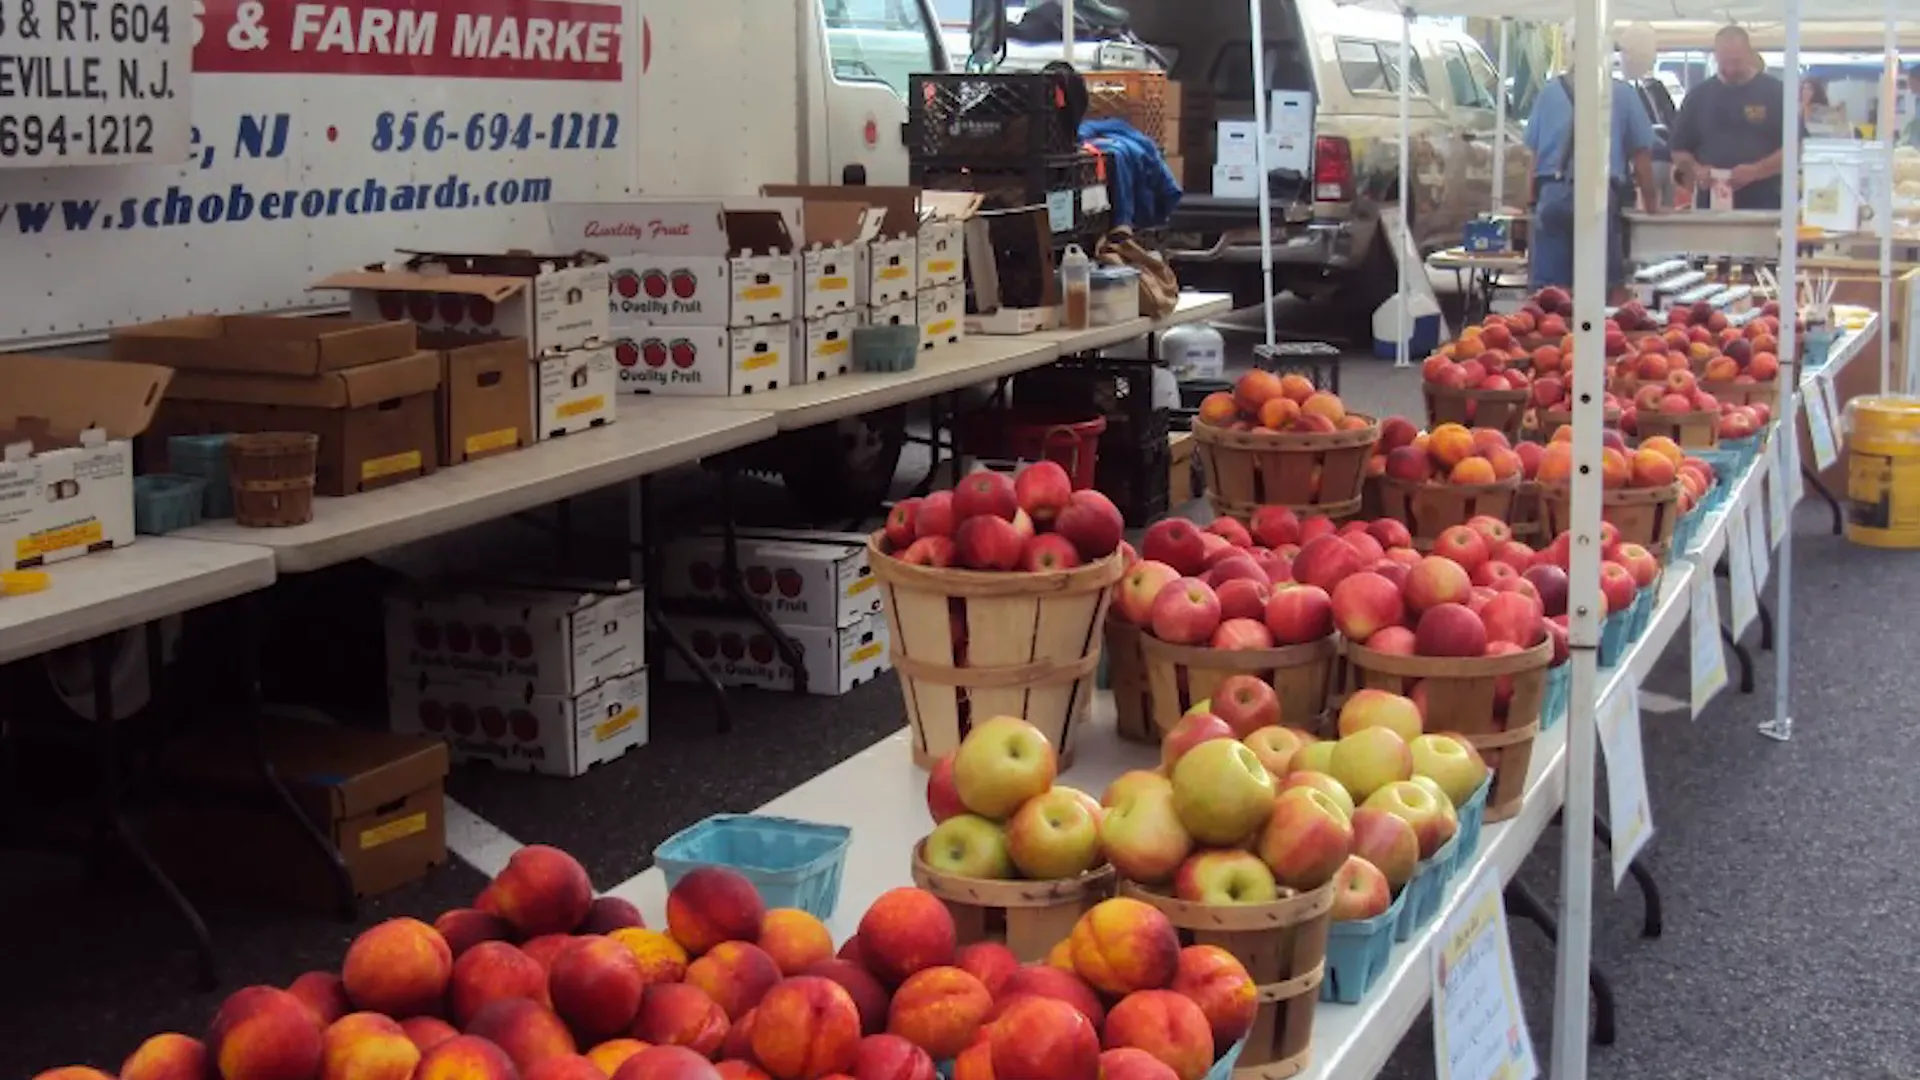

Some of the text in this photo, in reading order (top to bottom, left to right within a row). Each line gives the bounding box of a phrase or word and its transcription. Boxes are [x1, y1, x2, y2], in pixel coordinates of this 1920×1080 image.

[19, 0, 41, 39] &
[57, 0, 99, 42] RT.
[111, 3, 170, 43] 604
[227, 1, 269, 50] &
[290, 3, 439, 56] FARM
[0, 56, 107, 102] EVILLE,
[0, 114, 154, 157] 694-1212
[234, 113, 290, 159] NJ
[371, 110, 619, 152] 856-694-1212
[0, 175, 552, 234] ww.schoberorchards.com
[583, 219, 690, 240] Quality Fruit
[622, 300, 668, 316] Quality
[672, 300, 702, 314] Fruit
[619, 369, 702, 385] Quality Fruit
